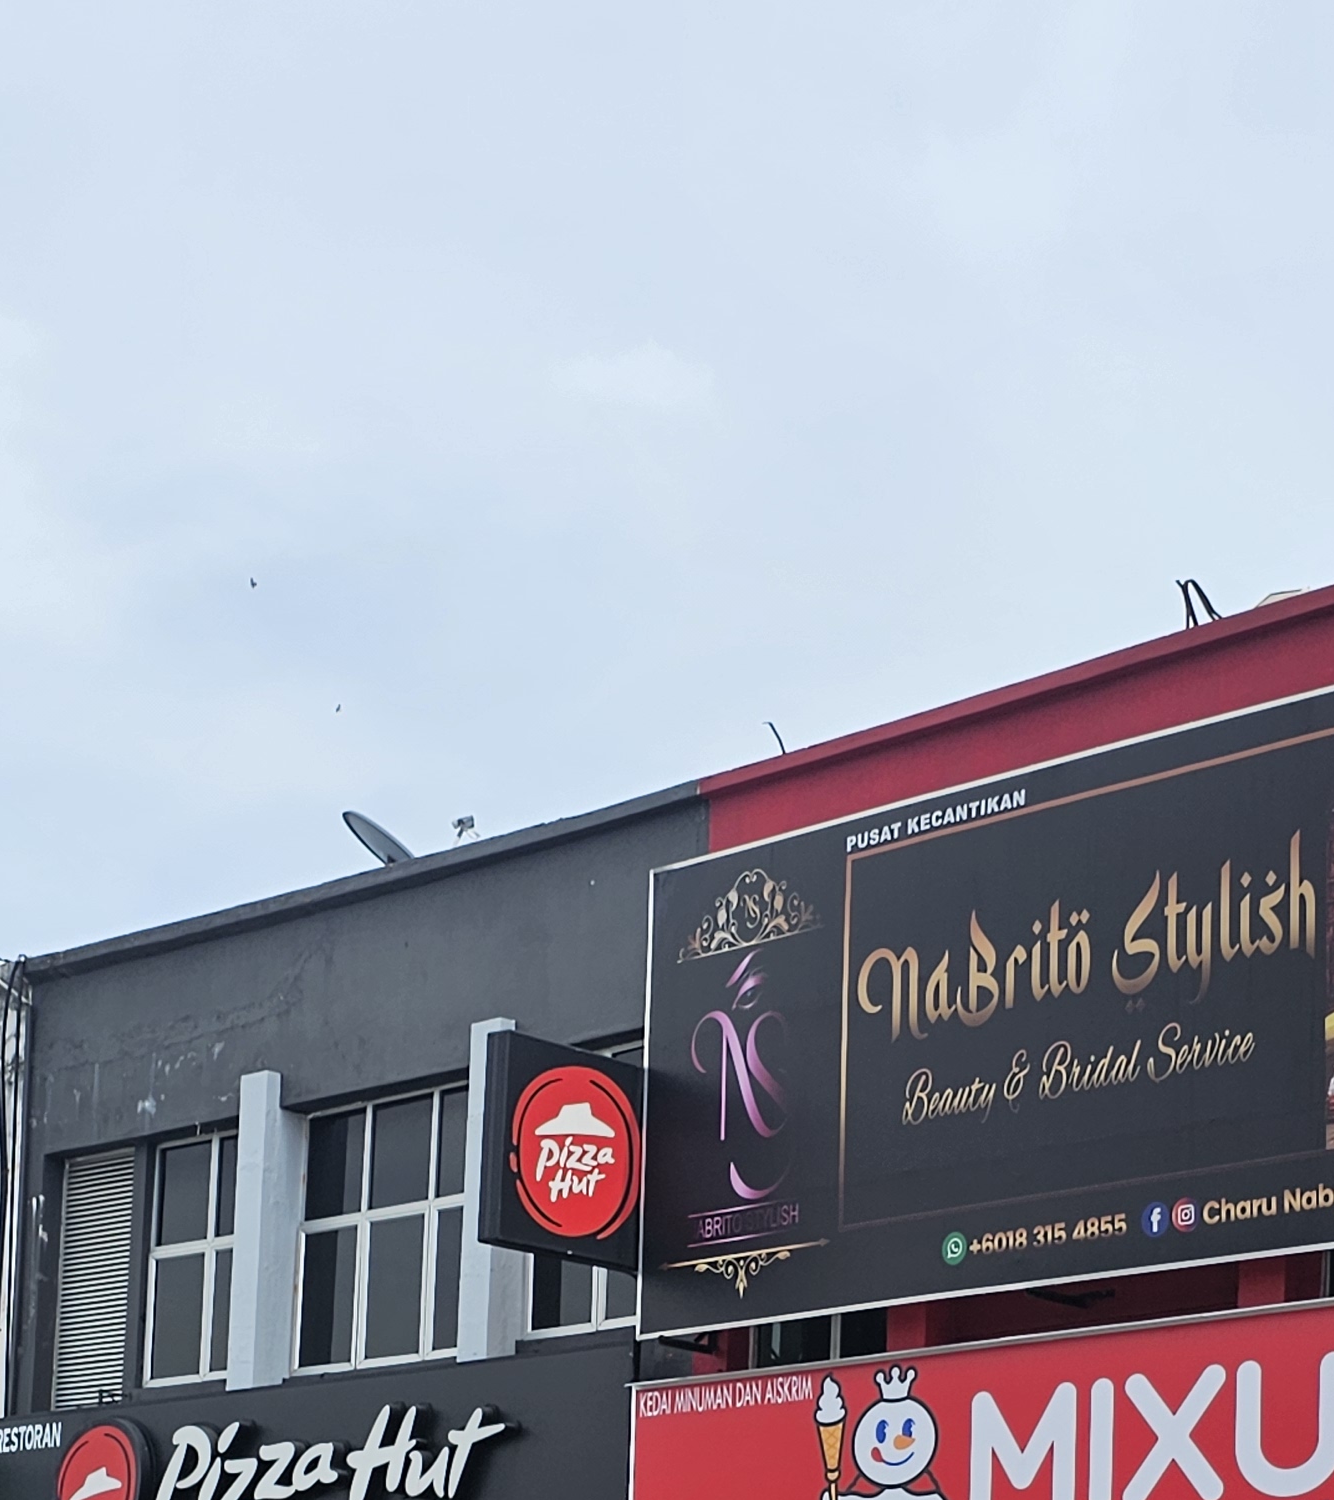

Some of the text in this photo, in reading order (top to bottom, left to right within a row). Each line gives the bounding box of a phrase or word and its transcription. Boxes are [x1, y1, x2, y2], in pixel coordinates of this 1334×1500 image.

[845, 788, 1027, 852] PUSAT KECANTIKAN
[901, 1022, 1257, 1126] Beauty & Bridal Service
[536, 1136, 616, 1181] Pizza
[549, 1168, 606, 1203] Hut
[1202, 1196, 1278, 1228] Charu
[969, 1212, 1128, 1259] +6018 315 4855
[639, 1373, 814, 1417] KEDAI MINUMAN DAN AISKRIM
